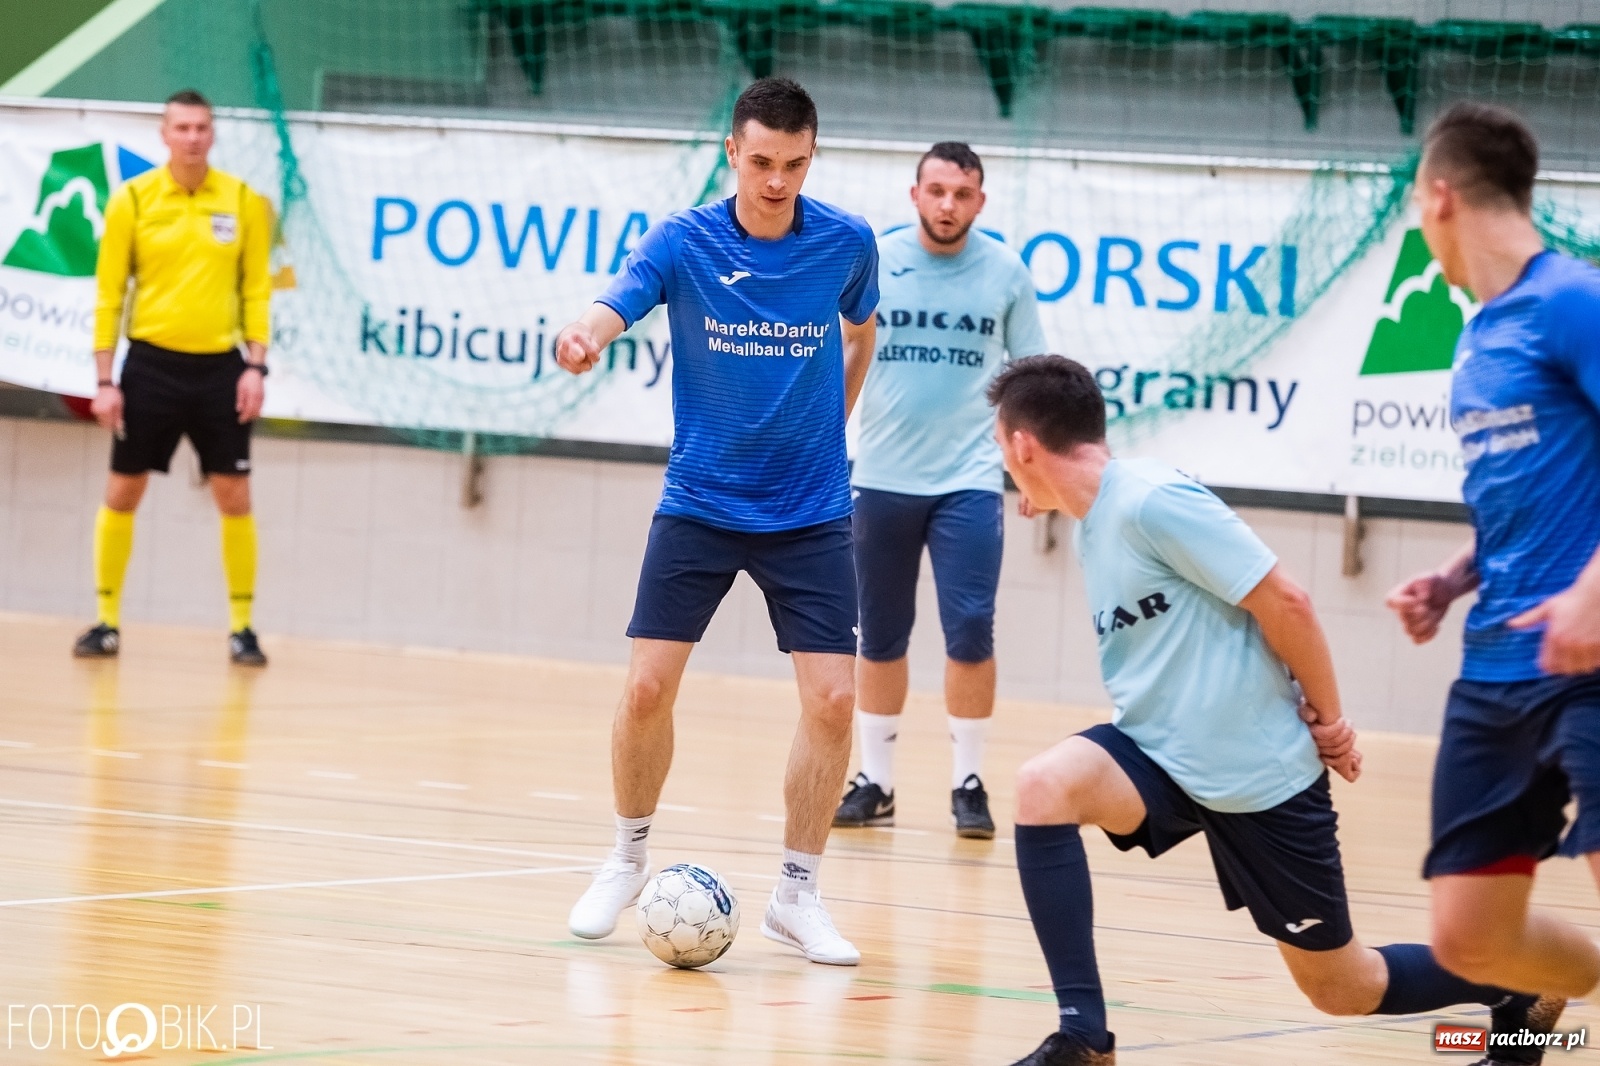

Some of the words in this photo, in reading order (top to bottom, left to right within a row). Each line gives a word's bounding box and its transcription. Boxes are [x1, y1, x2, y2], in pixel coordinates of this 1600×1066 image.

[978, 227, 1299, 319] ORSKI
[708, 336, 785, 357] Metallbau
[1352, 391, 1457, 438] powi
